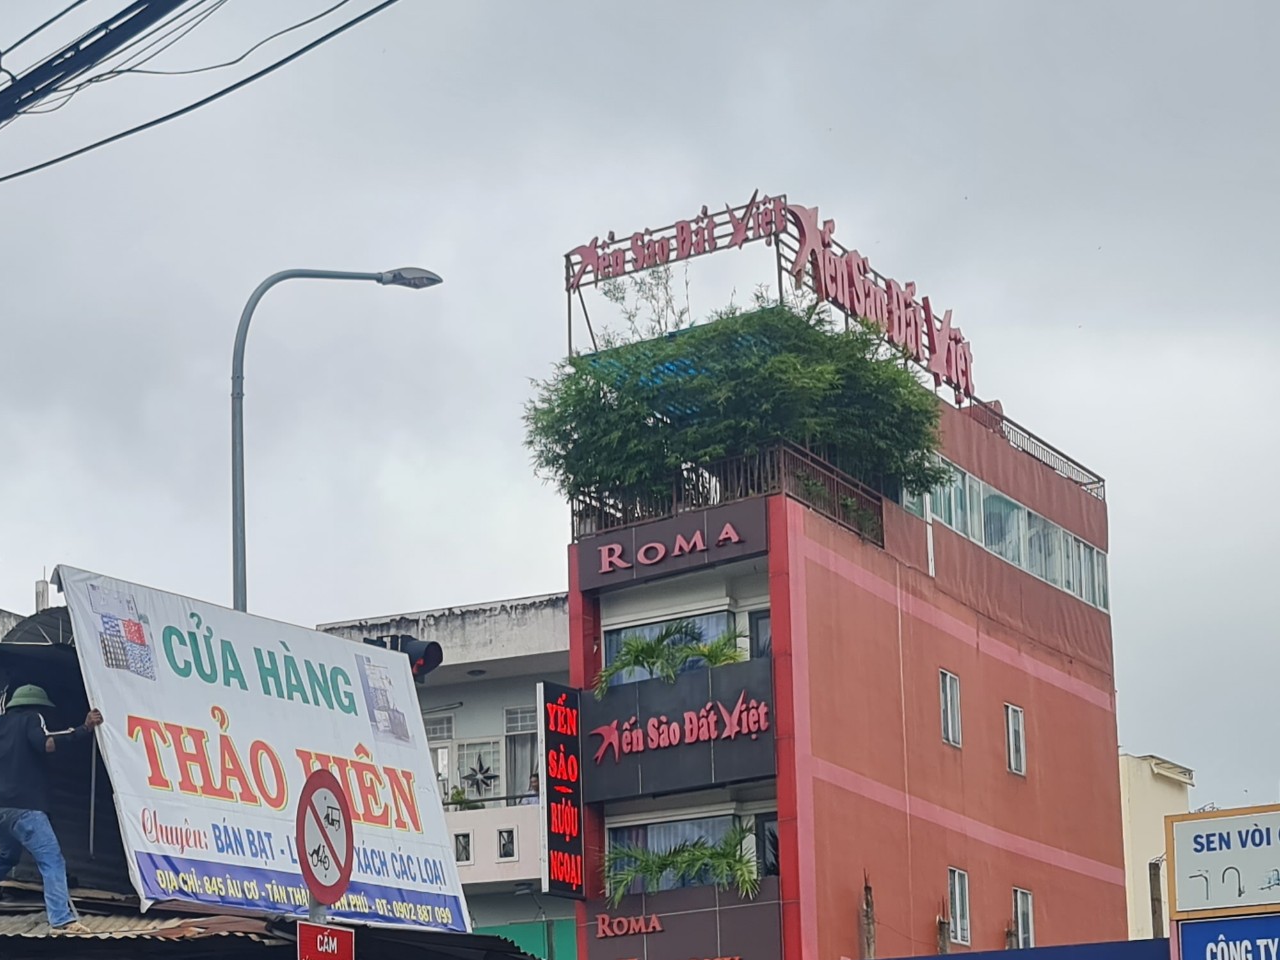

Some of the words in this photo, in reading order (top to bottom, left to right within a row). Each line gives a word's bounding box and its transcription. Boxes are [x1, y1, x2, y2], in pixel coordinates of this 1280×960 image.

[597, 520, 741, 576] ROMA
[161, 612, 249, 691] CỬA
[253, 640, 358, 717] HÀNG
[546, 693, 577, 736] YẾN
[647, 715, 680, 749] Sào
[683, 702, 718, 744] Đất
[717, 689, 769, 740] Việt
[127, 705, 289, 811] THẢO
[548, 744, 578, 782] SÀO
[141, 807, 209, 854] Chuyên:
[211, 817, 246, 857] BÁN
[246, 828, 275, 866] BẠT
[550, 798, 578, 842] RƯỢU
[1193, 831, 1232, 853] SEN
[1237, 823, 1272, 849] VÒI
[353, 840, 390, 878] XÁCH
[390, 846, 417, 883] CÁC
[416, 856, 447, 891] LOẠI
[550, 849, 582, 890] NGOẠI
[156, 869, 178, 894] ĐỊA
[178, 868, 203, 894] CHỈ:
[205, 876, 225, 896] 845
[225, 874, 243, 899] ÂU
[243, 879, 258, 900] CƠ
[265, 880, 287, 904] TÂN
[287, 883, 310, 907] THÀ
[349, 892, 369, 914] PHÚ
[376, 898, 393, 916] ĐT:
[393, 901, 416, 920] 0902
[417, 904, 433, 922] 887
[435, 907, 452, 924] 099
[317, 929, 337, 954] CẤM
[596, 914, 663, 938] ROMA
